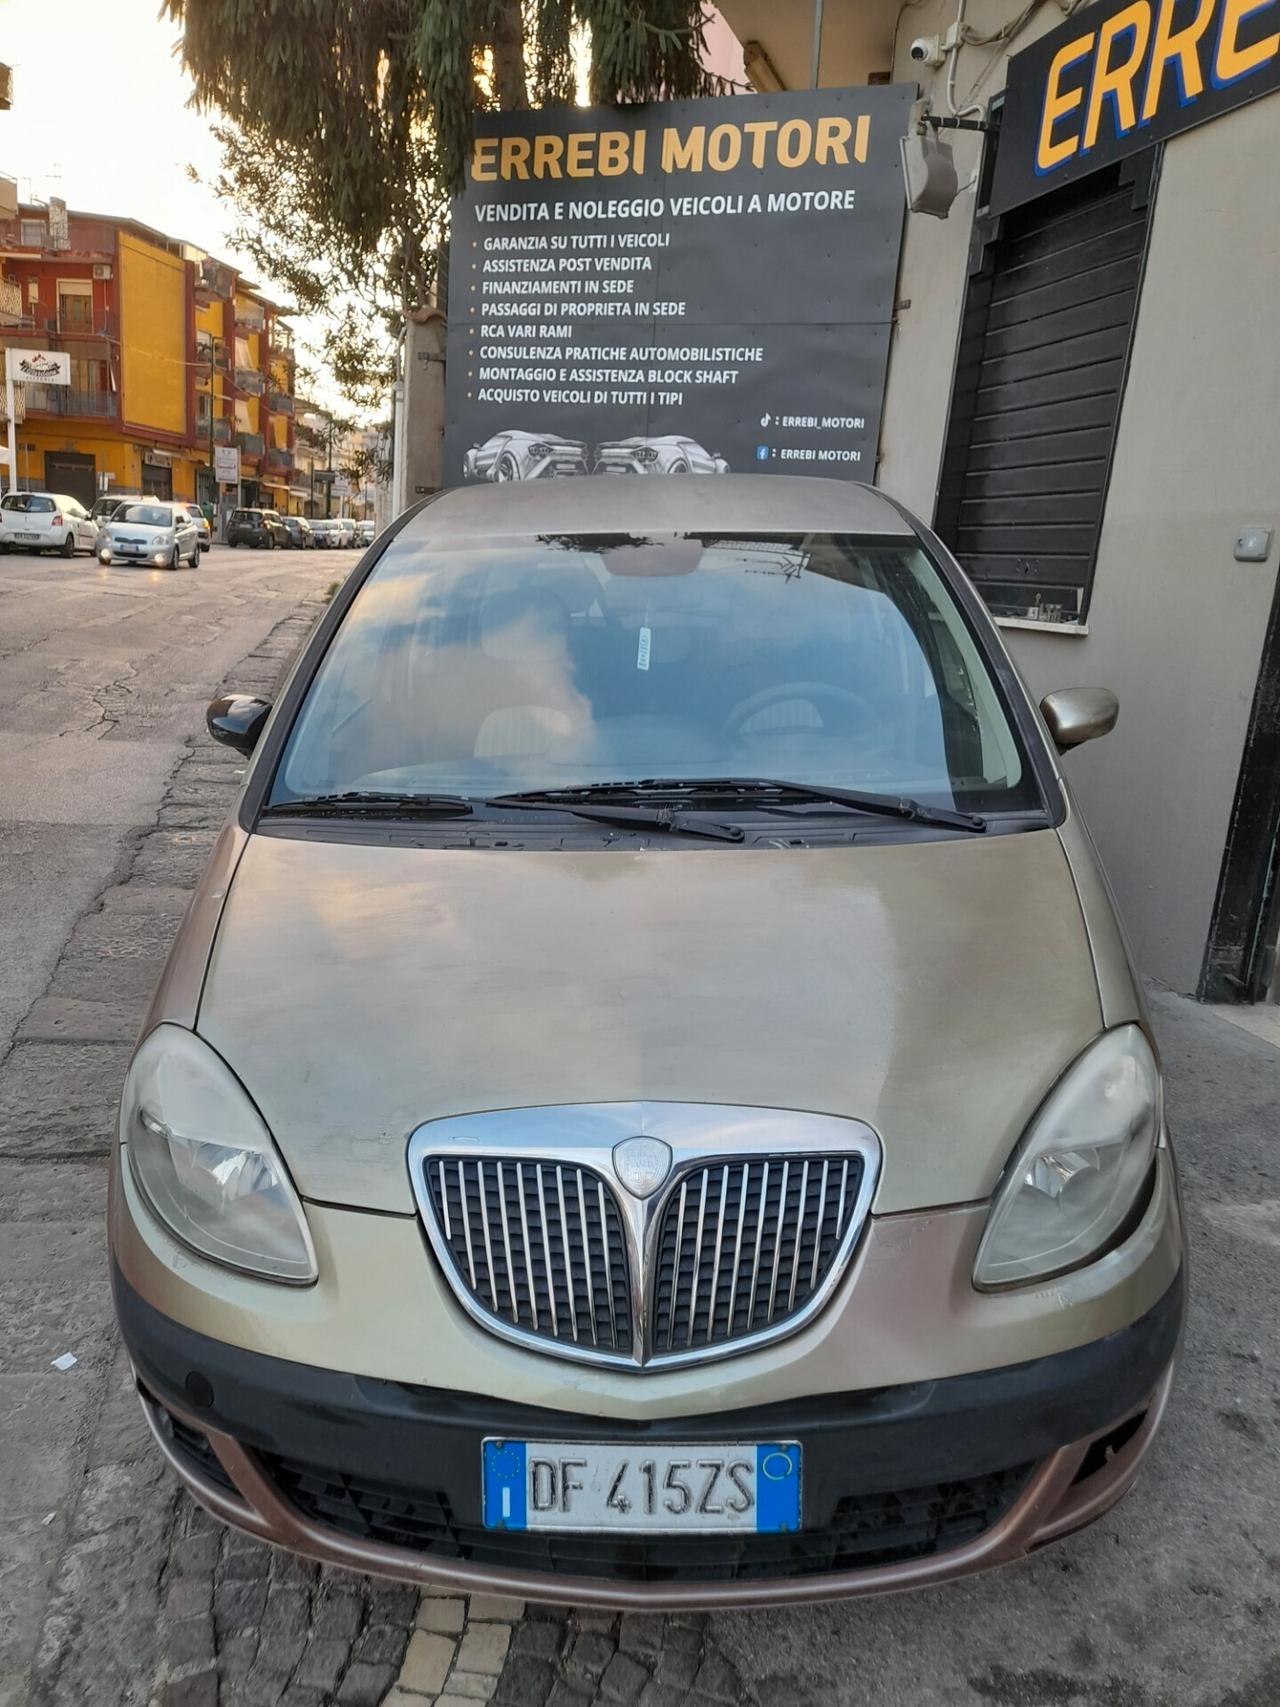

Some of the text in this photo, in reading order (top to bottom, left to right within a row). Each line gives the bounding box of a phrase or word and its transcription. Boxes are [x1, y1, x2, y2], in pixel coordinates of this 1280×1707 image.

[471, 115, 871, 181] ERREBI MOTORI
[475, 190, 855, 222] VENDITA E NOLEGGIO VEICOLI A MOTORE
[484, 233, 670, 250] GARANZIA SU TUTTI I VEICOLI
[483, 257, 652, 272] ASSISTENZA POST VENDITA
[482, 280, 634, 294] FINANZIAMENTI IN SEDE
[481, 302, 686, 316] PASSAGGI DI PROPRIETA IN SEDE
[480, 325, 572, 338] RCA VARI RAMI
[480, 346, 763, 361] CONSULENZA PRATICHE AUTOMOBILISTICHE
[479, 367, 739, 384] MONTAGGIO E ASSISTENZA BLOCK SHAFT
[478, 389, 683, 406] ACQUISTO VEICOLI DI TUTTI I TIPI
[782, 416, 865, 429] ERREBI_MOTORI
[781, 449, 816, 460] ERREBI
[818, 450, 861, 461] MOTORI
[530, 1456, 587, 1513] DF
[606, 1460, 755, 1514] 415ZS
